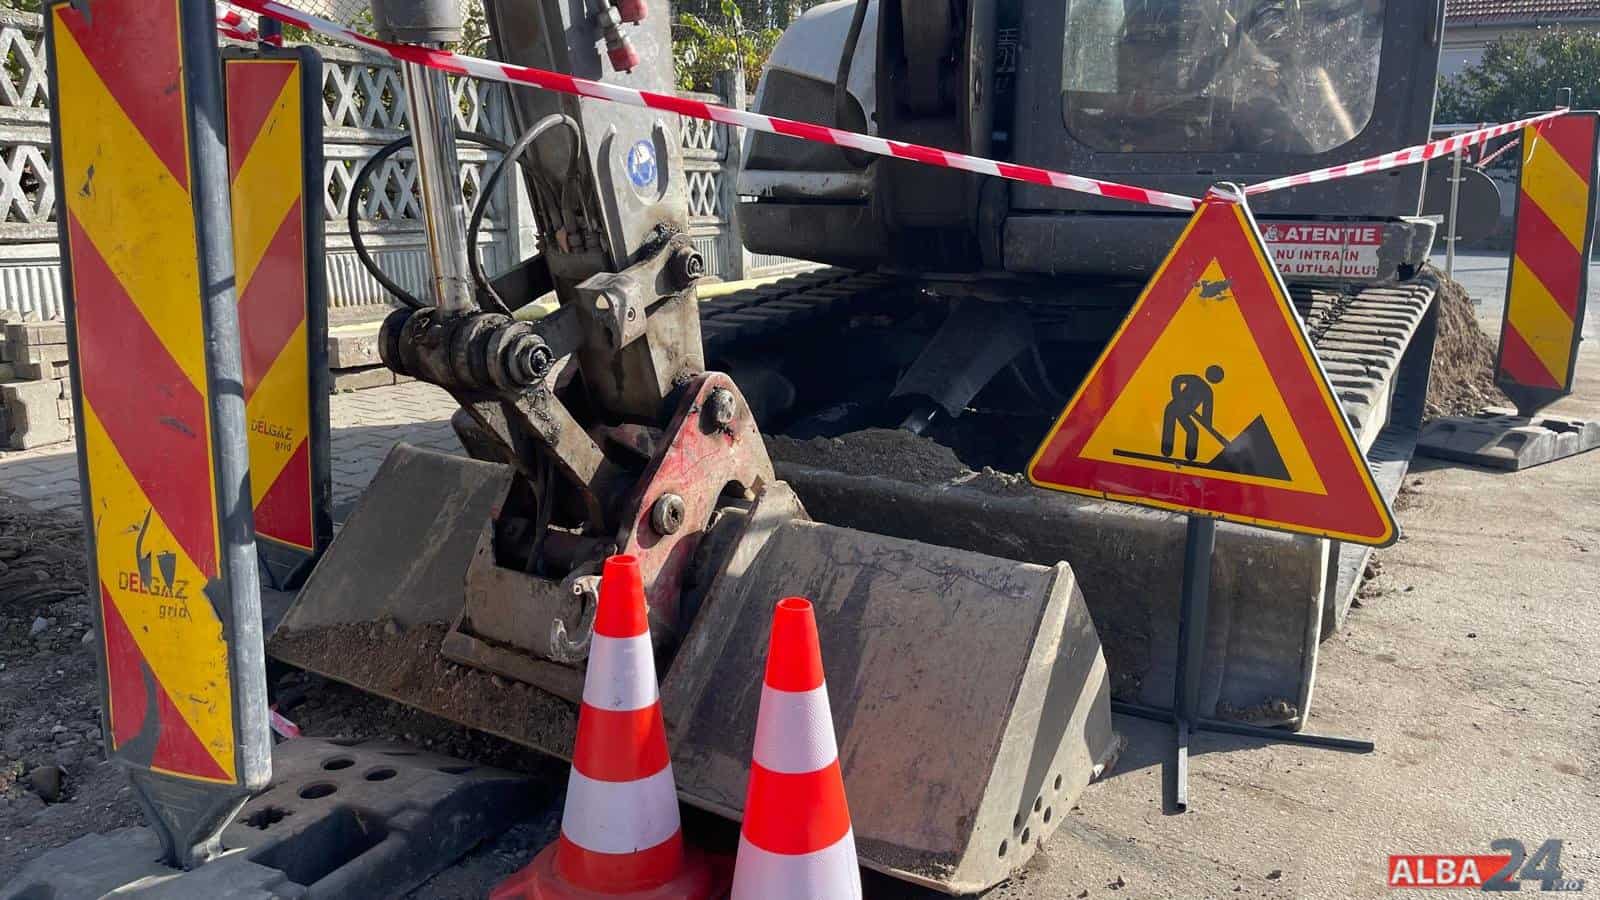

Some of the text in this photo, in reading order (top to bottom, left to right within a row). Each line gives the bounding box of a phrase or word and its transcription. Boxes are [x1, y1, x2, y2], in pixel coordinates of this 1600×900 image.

[1285, 227, 1377, 242] ATENTIE
[1276, 250, 1359, 261] NU INTRA IN
[250, 420, 292, 441] DELGAZ
[159, 602, 188, 619] grid
